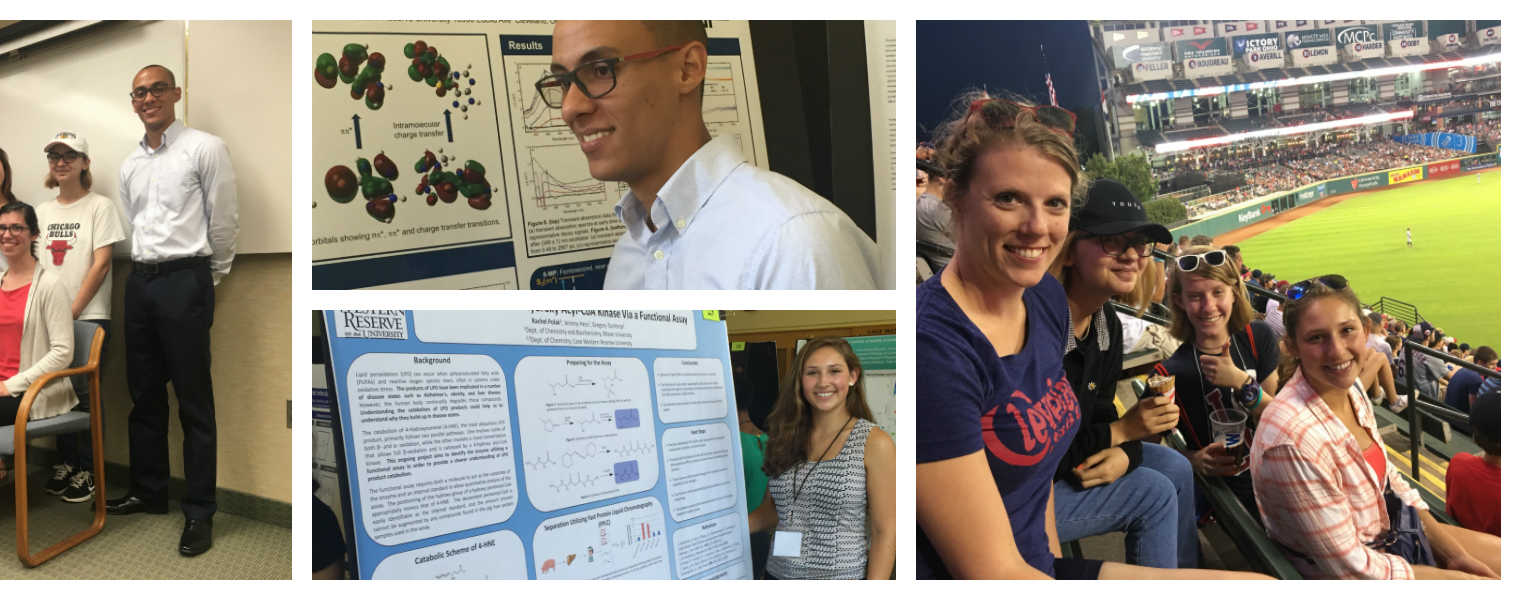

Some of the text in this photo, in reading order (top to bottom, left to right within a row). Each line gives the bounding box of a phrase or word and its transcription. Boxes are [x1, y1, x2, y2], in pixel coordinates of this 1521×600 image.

[508, 41, 543, 50] Results
[1363, 43, 1383, 51] HARDER
[1260, 53, 1282, 61] AVERILL
[1310, 49, 1329, 57] LEMON
[1145, 62, 1169, 72] FELLER
[1197, 58, 1229, 68] BOUDREAU
[393, 120, 440, 129] Intramolecular
[394, 129, 444, 139] charge transfer
[1359, 175, 1380, 183] University
[1238, 209, 1261, 223] KeyBank
[47, 222, 81, 232] CHICAGO
[312, 235, 338, 246] orbitals
[340, 232, 371, 244] showing
[401, 227, 416, 236] and
[416, 225, 440, 235] charge
[440, 222, 466, 231] transfer
[467, 218, 501, 229] transitions.
[49, 230, 74, 238] BULLS
[344, 311, 404, 331] RESERVE
[597, 310, 621, 319] Kinase
[622, 310, 633, 319] Via
[639, 311, 671, 323] Functional
[672, 316, 688, 325] Assay
[363, 330, 404, 339] UNIVERSITY
[413, 356, 452, 365] Background
[544, 501, 653, 532] Separation Utilizing Fast Protein Liquid Chromatography
[414, 539, 496, 565] Catabolic Scheme of 4-HNE
